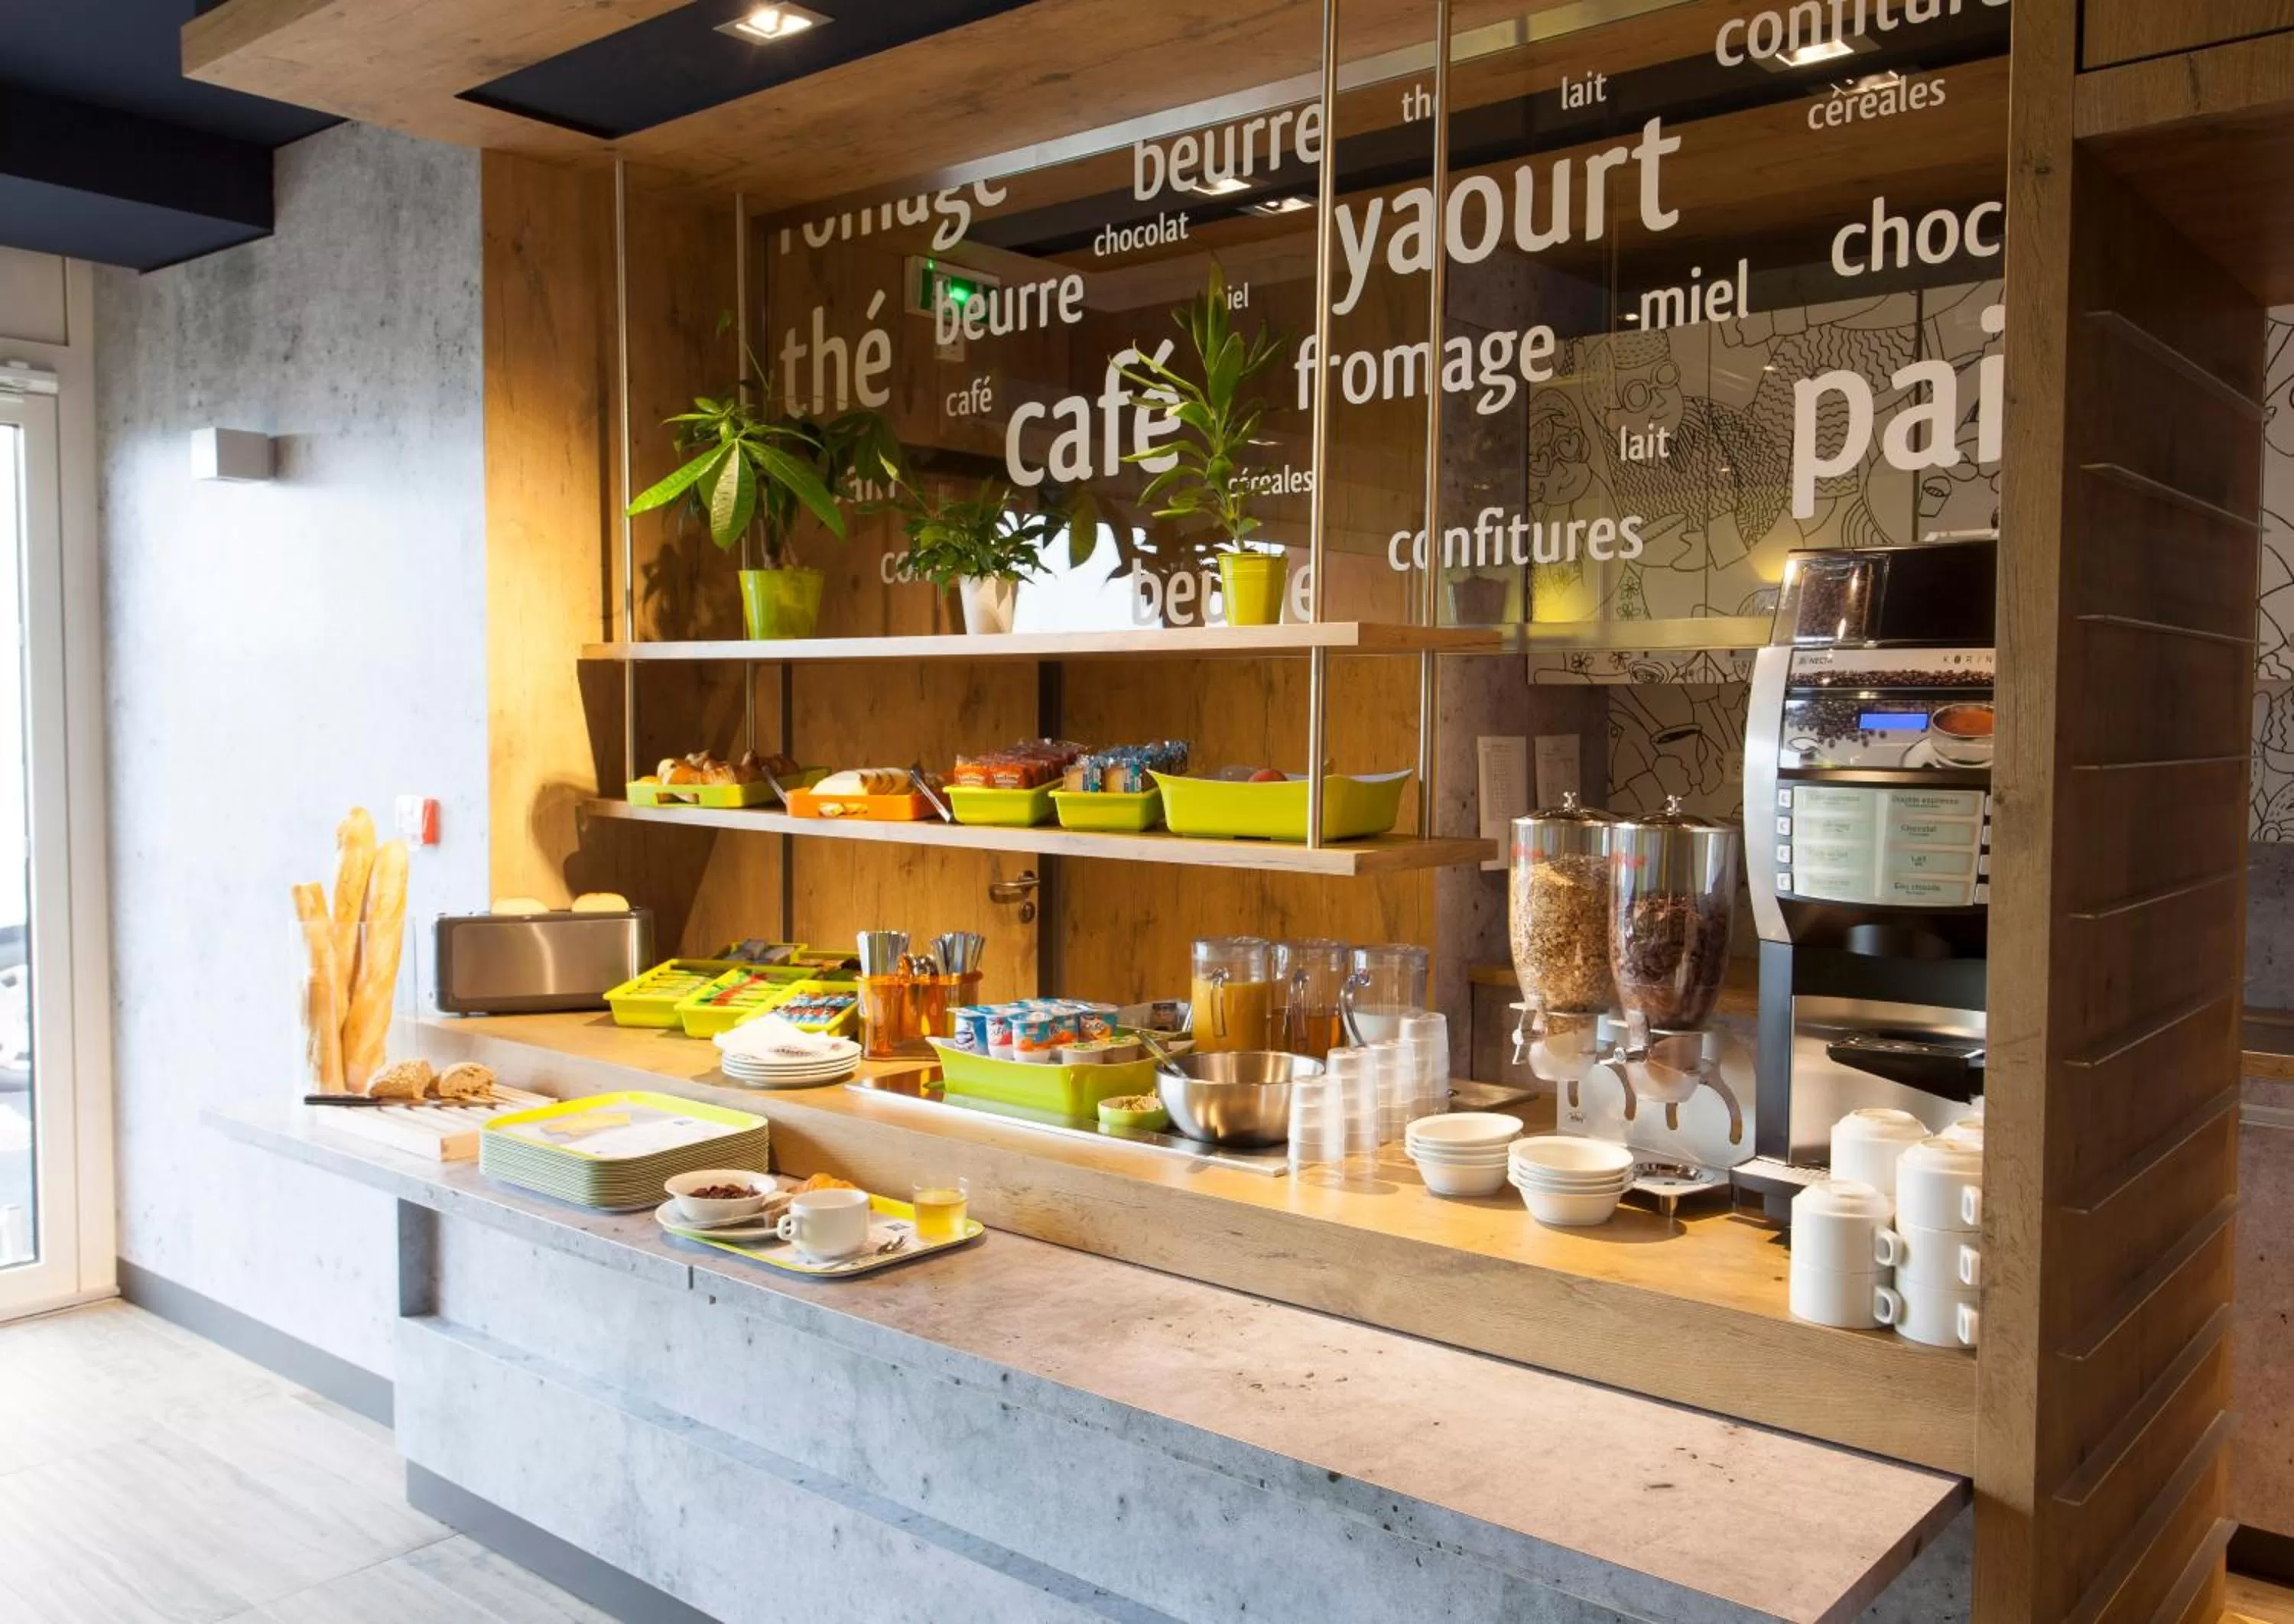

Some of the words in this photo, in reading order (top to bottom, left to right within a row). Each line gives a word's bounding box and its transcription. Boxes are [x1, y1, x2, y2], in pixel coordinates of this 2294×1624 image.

[1715, 0, 2009, 67] confitu
[1401, 83, 1437, 122] th
[1561, 71, 1607, 110] lait
[1134, 104, 1321, 200] beurre
[1094, 212, 1189, 257] chocolat
[1331, 116, 1682, 315] yaourt
[1831, 196, 2003, 278] choc
[936, 274, 1084, 345] beurre
[1227, 282, 1249, 310] iel
[1640, 258, 1749, 331] miel
[779, 289, 892, 419] thé
[947, 375, 992, 417] café
[1006, 339, 1181, 487] café
[1792, 304, 2004, 519] pai
[1620, 423, 1670, 461] lait
[1388, 507, 1643, 571] confitures
[1132, 558, 1311, 625] beue
